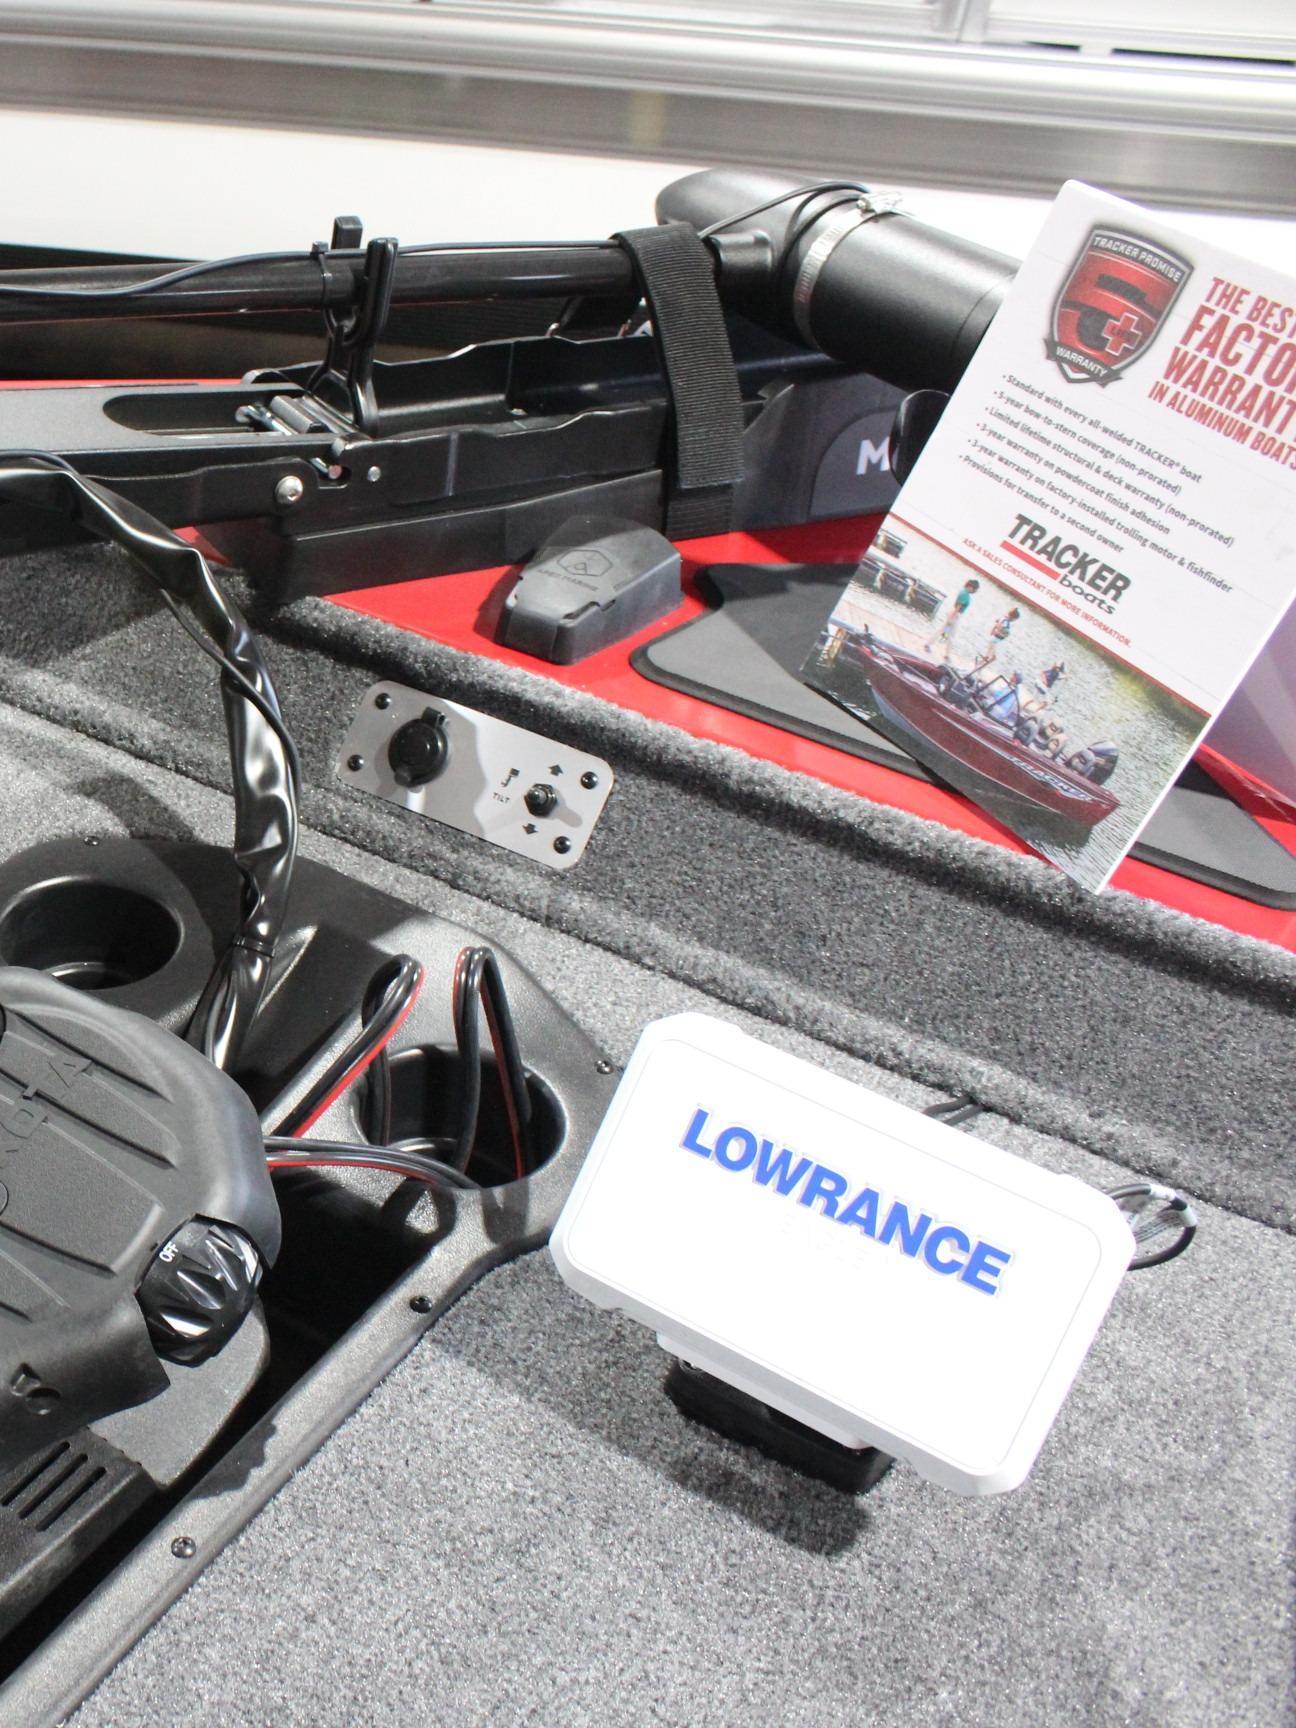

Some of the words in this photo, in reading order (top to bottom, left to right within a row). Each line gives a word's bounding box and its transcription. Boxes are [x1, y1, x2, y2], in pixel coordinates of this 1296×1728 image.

[1095, 236, 1140, 259] TRACKER
[1138, 252, 1182, 282] PROMISE
[1180, 305, 1296, 395] FACTO
[1205, 276, 1251, 316] THE
[1246, 295, 1296, 338] BES
[1057, 347, 1107, 376] WARRANTY
[1162, 346, 1296, 443] WARRANT
[998, 391, 1024, 409] 5-year
[1024, 405, 1077, 438] bow-to-stern
[1077, 436, 1115, 459] coverage
[1115, 454, 1181, 496] (non-prorated)
[1007, 375, 1045, 399] Standard
[1044, 396, 1063, 409] with
[1064, 407, 1088, 423] every
[1088, 419, 1134, 446] all-welded
[1180, 466, 1202, 483] boat
[1148, 382, 1167, 404] IN
[1167, 391, 1253, 444] ALUMINUM
[963, 455, 1003, 483] Provisions
[1003, 478, 1016, 490] for
[1017, 487, 1050, 509] transfer
[1050, 506, 1059, 516] to
[1066, 517, 1097, 537] second
[1096, 534, 1124, 552] owner
[972, 440, 997, 457] 3-year
[998, 455, 1034, 480] warranty
[1034, 477, 1045, 486] on
[1046, 481, 1117, 526] factory-installed
[1116, 522, 1149, 547] trolling
[1149, 542, 1178, 560] motor
[1177, 557, 1185, 566] &
[1186, 561, 1233, 593] fishfinder
[989, 407, 1021, 429] Limited
[1020, 424, 1052, 446] lifetime
[1052, 443, 1095, 470] structural
[1094, 465, 1101, 474] &
[1102, 470, 1124, 486] deck
[1124, 483, 1165, 510] warranty
[1165, 504, 1234, 548] (non-prorated)
[1006, 439, 1043, 464] warranty
[1043, 460, 1055, 470] on
[1054, 467, 1105, 497] powdercoat
[1105, 493, 1130, 512] finish
[1130, 509, 1170, 534] adhesion
[963, 538, 977, 549] ASK
[982, 550, 1003, 566] SALES
[1003, 563, 1046, 592] CONSULTANT
[1046, 589, 1061, 602] FOR
[1060, 599, 1081, 615] MORE
[1008, 514, 1131, 603] TRACKER
[1059, 574, 1115, 614] boats
[683, 1109, 1011, 1295] LOWRANCE
[159, 1241, 179, 1262] OFF
